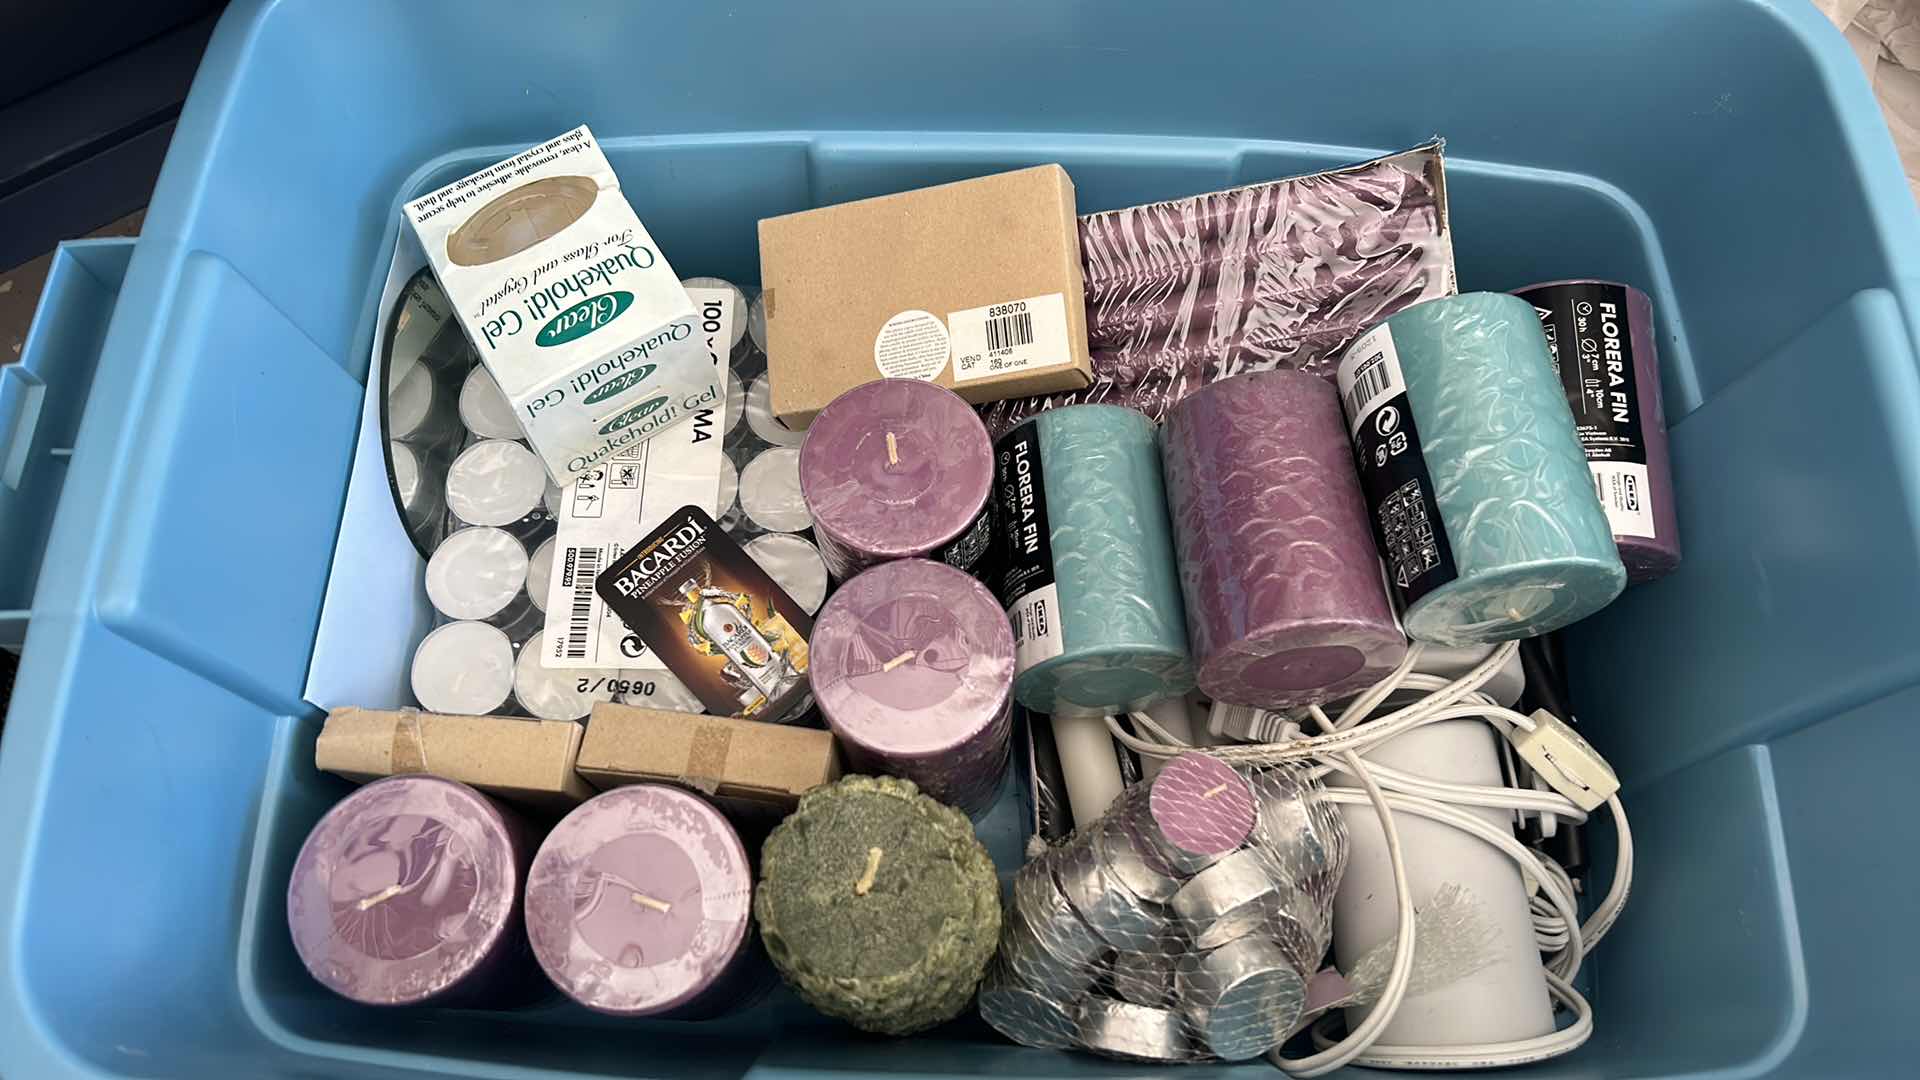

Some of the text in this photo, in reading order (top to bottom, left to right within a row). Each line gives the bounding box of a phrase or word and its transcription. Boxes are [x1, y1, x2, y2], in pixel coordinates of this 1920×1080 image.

[545, 138, 561, 151] and
[562, 129, 584, 143] glass
[585, 140, 592, 149] A
[495, 160, 517, 174] from
[516, 147, 544, 166] crystal
[516, 153, 559, 176] removable
[456, 169, 495, 192] breakage
[477, 172, 513, 191] adhesive
[439, 187, 455, 199] and
[445, 195, 466, 209] help
[466, 188, 477, 199] to
[417, 206, 446, 224] secure
[604, 228, 634, 247] For
[563, 242, 599, 263] Glass
[532, 260, 559, 285] and
[481, 244, 655, 350] Quakehold! Gel
[547, 294, 618, 338] Clear
[703, 300, 722, 333] 100
[989, 301, 1026, 318] 838070
[1600, 302, 1624, 387] FLORERA
[526, 323, 692, 418] Quakehold! Gel
[593, 366, 647, 399] Clear
[609, 401, 660, 433] Clear
[1610, 391, 1630, 423] FIN
[568, 385, 717, 473] Quakehold! Gel
[1015, 440, 1039, 555] FLORERA FIN
[613, 516, 705, 597] BACARDÍ
[631, 561, 676, 599] PINEAPPLE
[675, 535, 707, 563] FUSION
[555, 637, 565, 658] 17952
[577, 677, 655, 696] 0650/2
